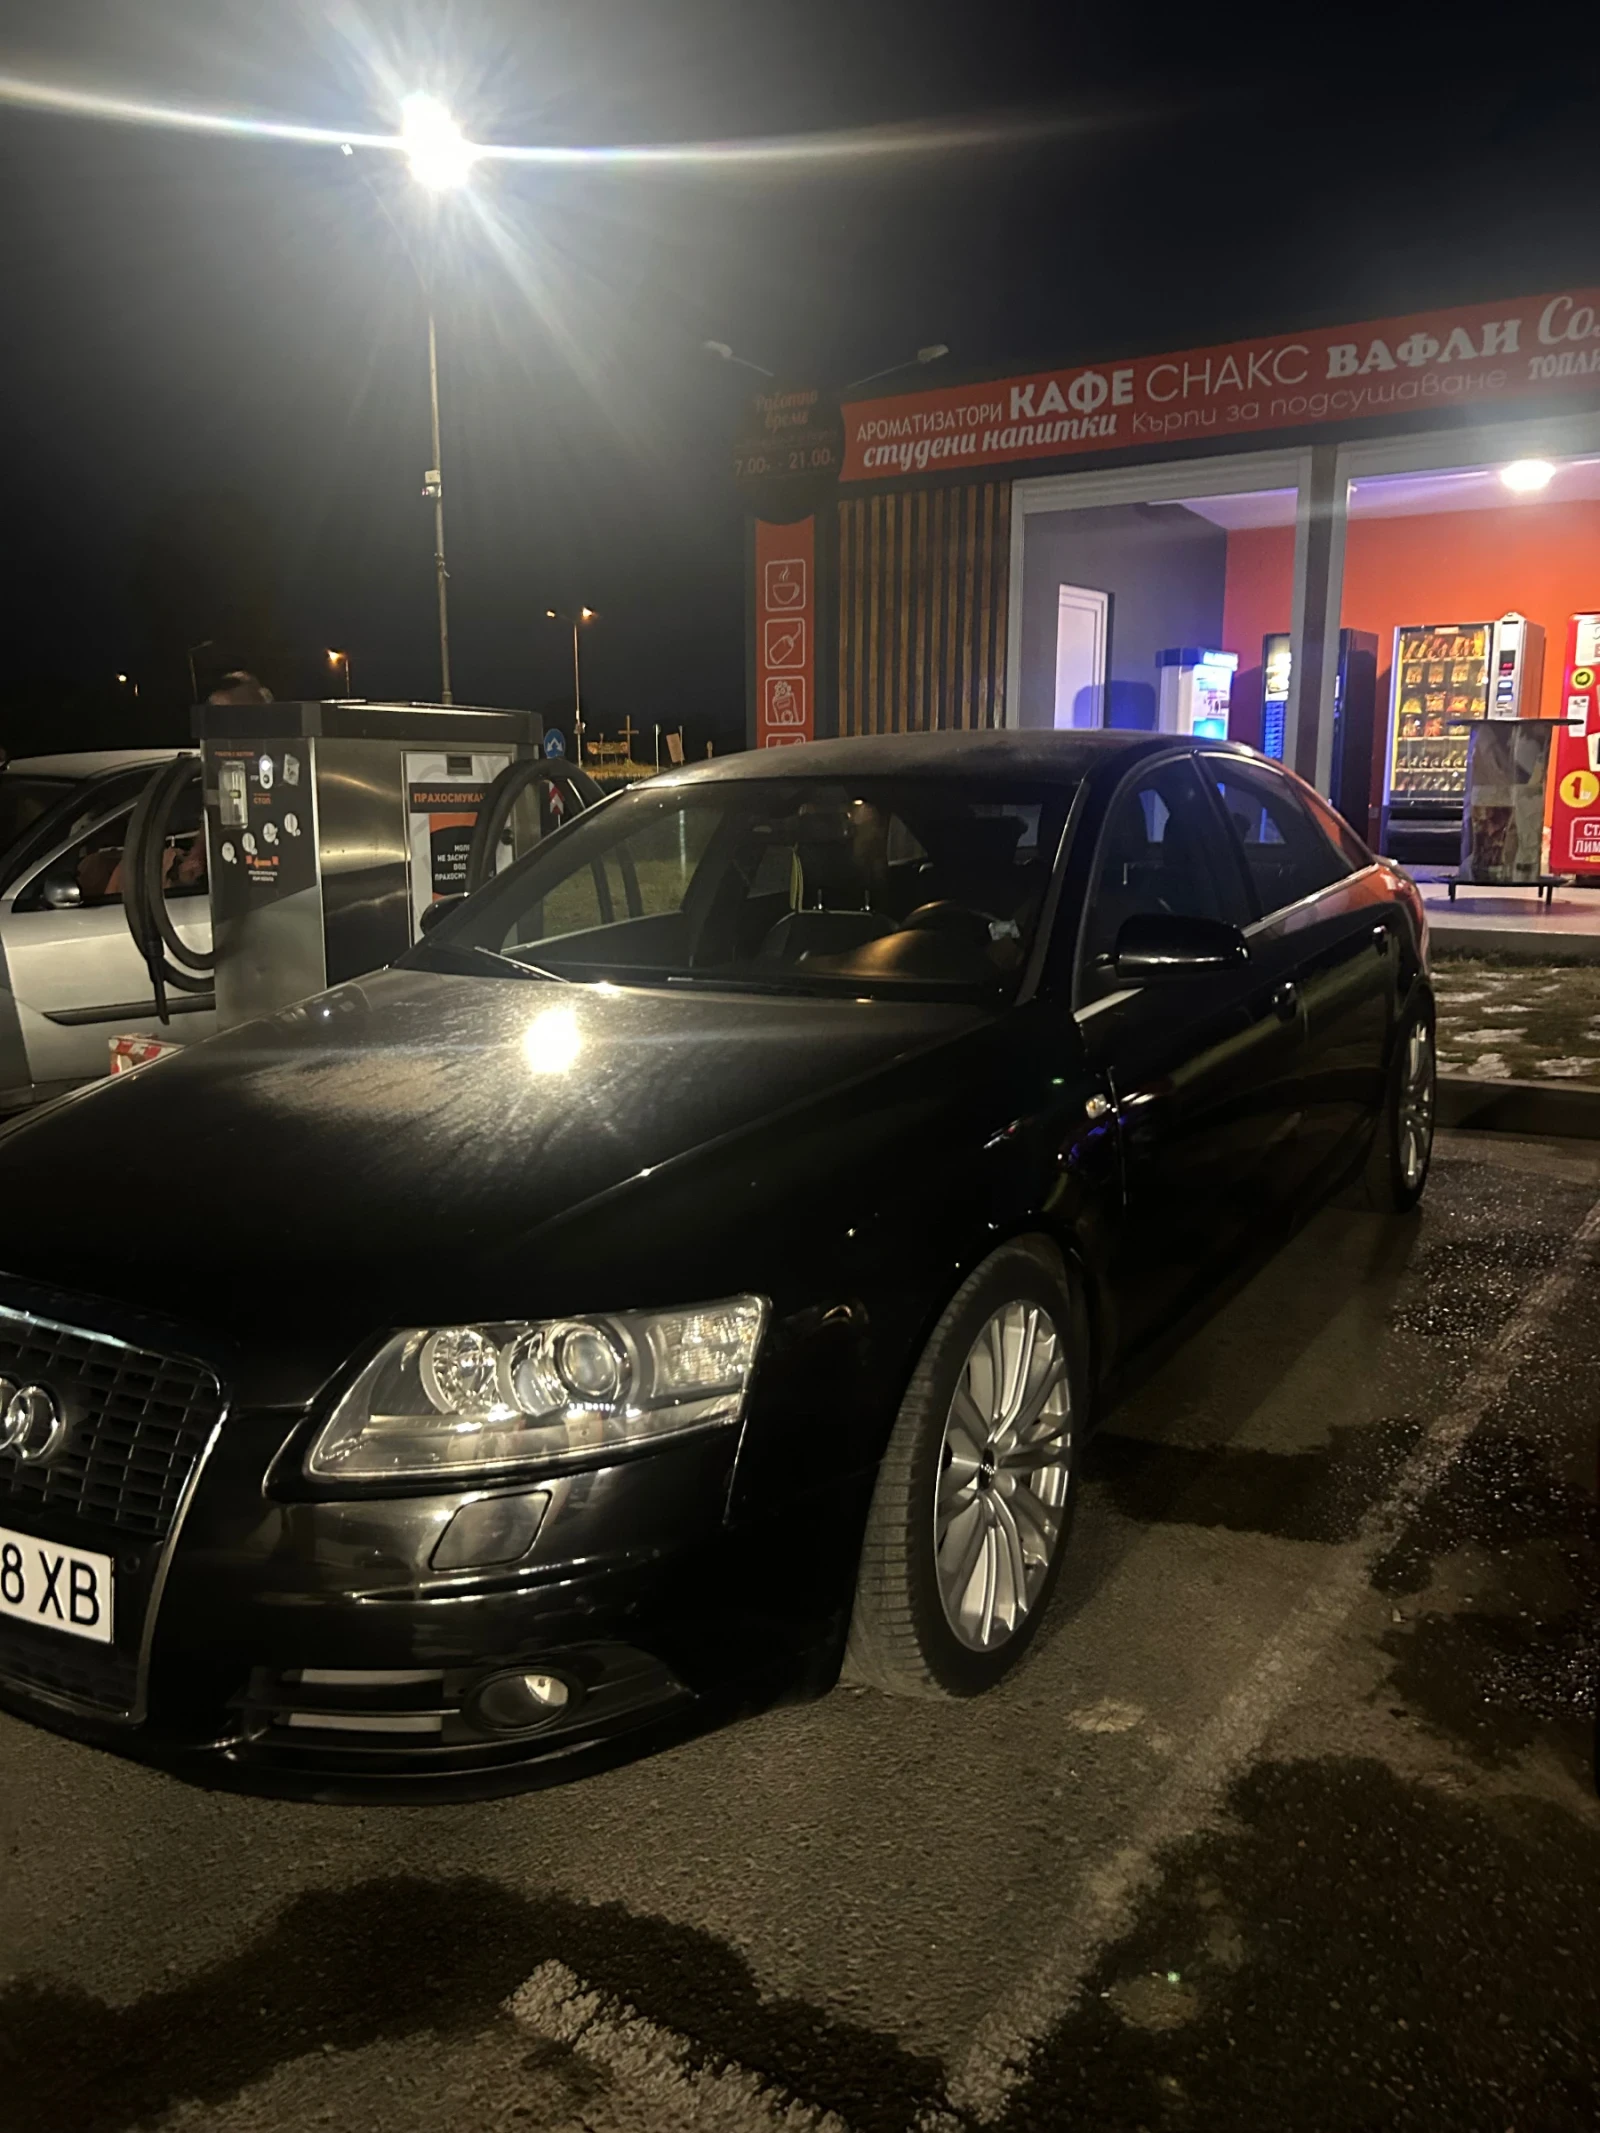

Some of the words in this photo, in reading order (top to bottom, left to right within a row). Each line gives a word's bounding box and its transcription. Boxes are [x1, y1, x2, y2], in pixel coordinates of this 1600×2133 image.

[1326, 318, 1522, 379] ВАФЛИ
[1537, 296, 1600, 345] Со
[1009, 369, 1134, 421] КАФЕ
[1146, 345, 1310, 403] СНАКС
[1226, 403, 1260, 421] за
[1270, 367, 1509, 420] подсушаване
[857, 401, 1003, 443] АРОМАТИЗАТОРИ
[862, 435, 977, 473] студени
[981, 410, 1118, 451] напитки
[1, 1543, 25, 1604] 8
